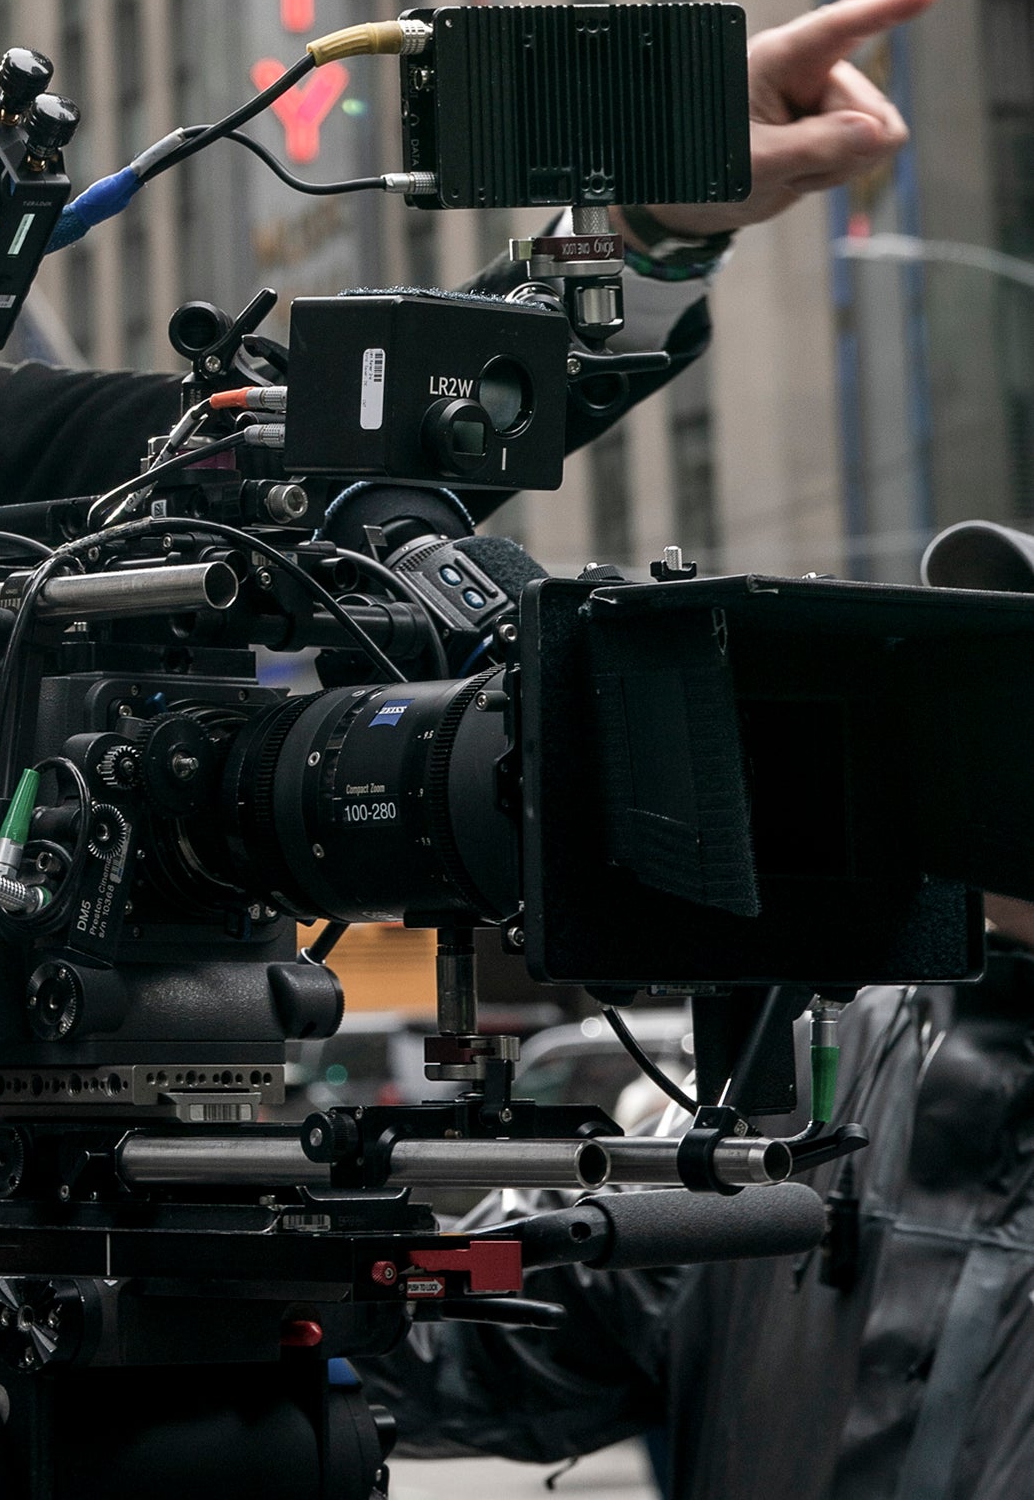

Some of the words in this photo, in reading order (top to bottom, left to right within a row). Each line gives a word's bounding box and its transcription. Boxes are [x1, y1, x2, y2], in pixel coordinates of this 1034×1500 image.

[410, 138, 420, 167] DATA
[429, 375, 473, 397] LR2W
[345, 784, 369, 795] Compact
[370, 783, 386, 794] Zoom
[344, 802, 397, 823] 100-280
[98, 857, 112, 894] Cinema
[102, 883, 116, 917] 10368
[76, 899, 92, 932] DM5
[97, 920, 109, 940] s/n
